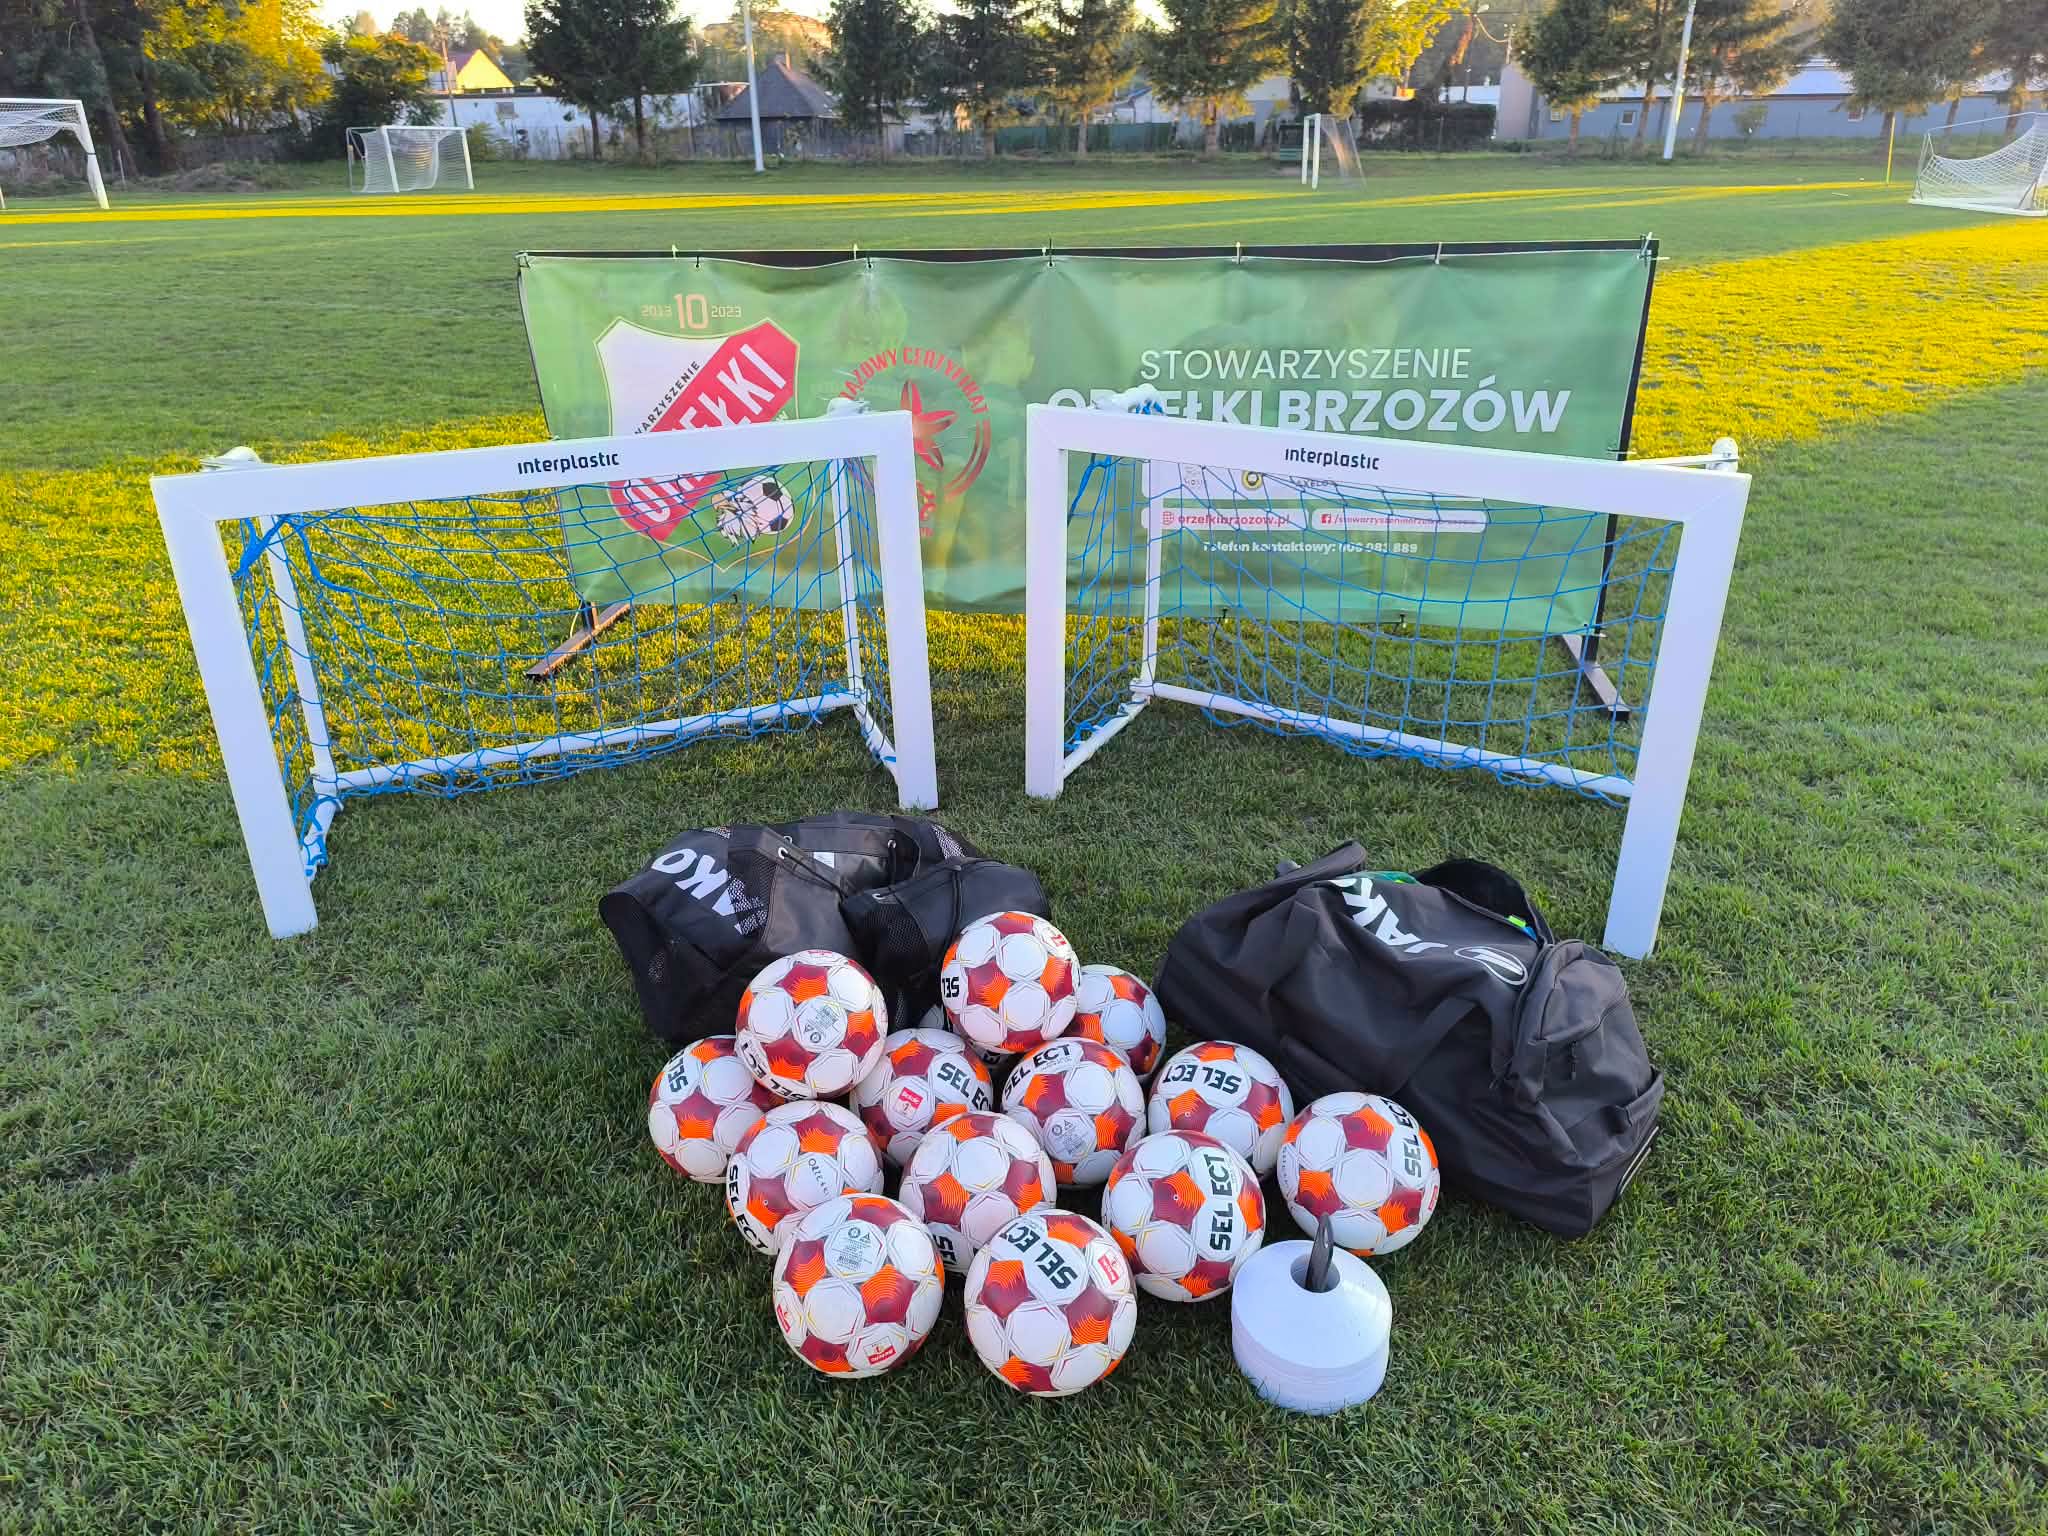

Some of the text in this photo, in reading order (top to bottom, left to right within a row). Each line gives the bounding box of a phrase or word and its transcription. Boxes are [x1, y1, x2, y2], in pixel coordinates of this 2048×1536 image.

[674, 294, 709, 330] 10
[711, 306, 742, 318] 2023
[1140, 349, 1471, 380] STOWARZYSZENIE
[1278, 375, 1571, 433] BRZOZÓW
[518, 453, 619, 475] interplastic
[1285, 447, 1380, 471] interplastic
[1005, 1044, 1070, 1100] SELECT
[1163, 1064, 1241, 1094] SELECT
[729, 1165, 768, 1248] SELECT
[1204, 1154, 1233, 1250] SELECT
[999, 1222, 1078, 1289] SELECT
